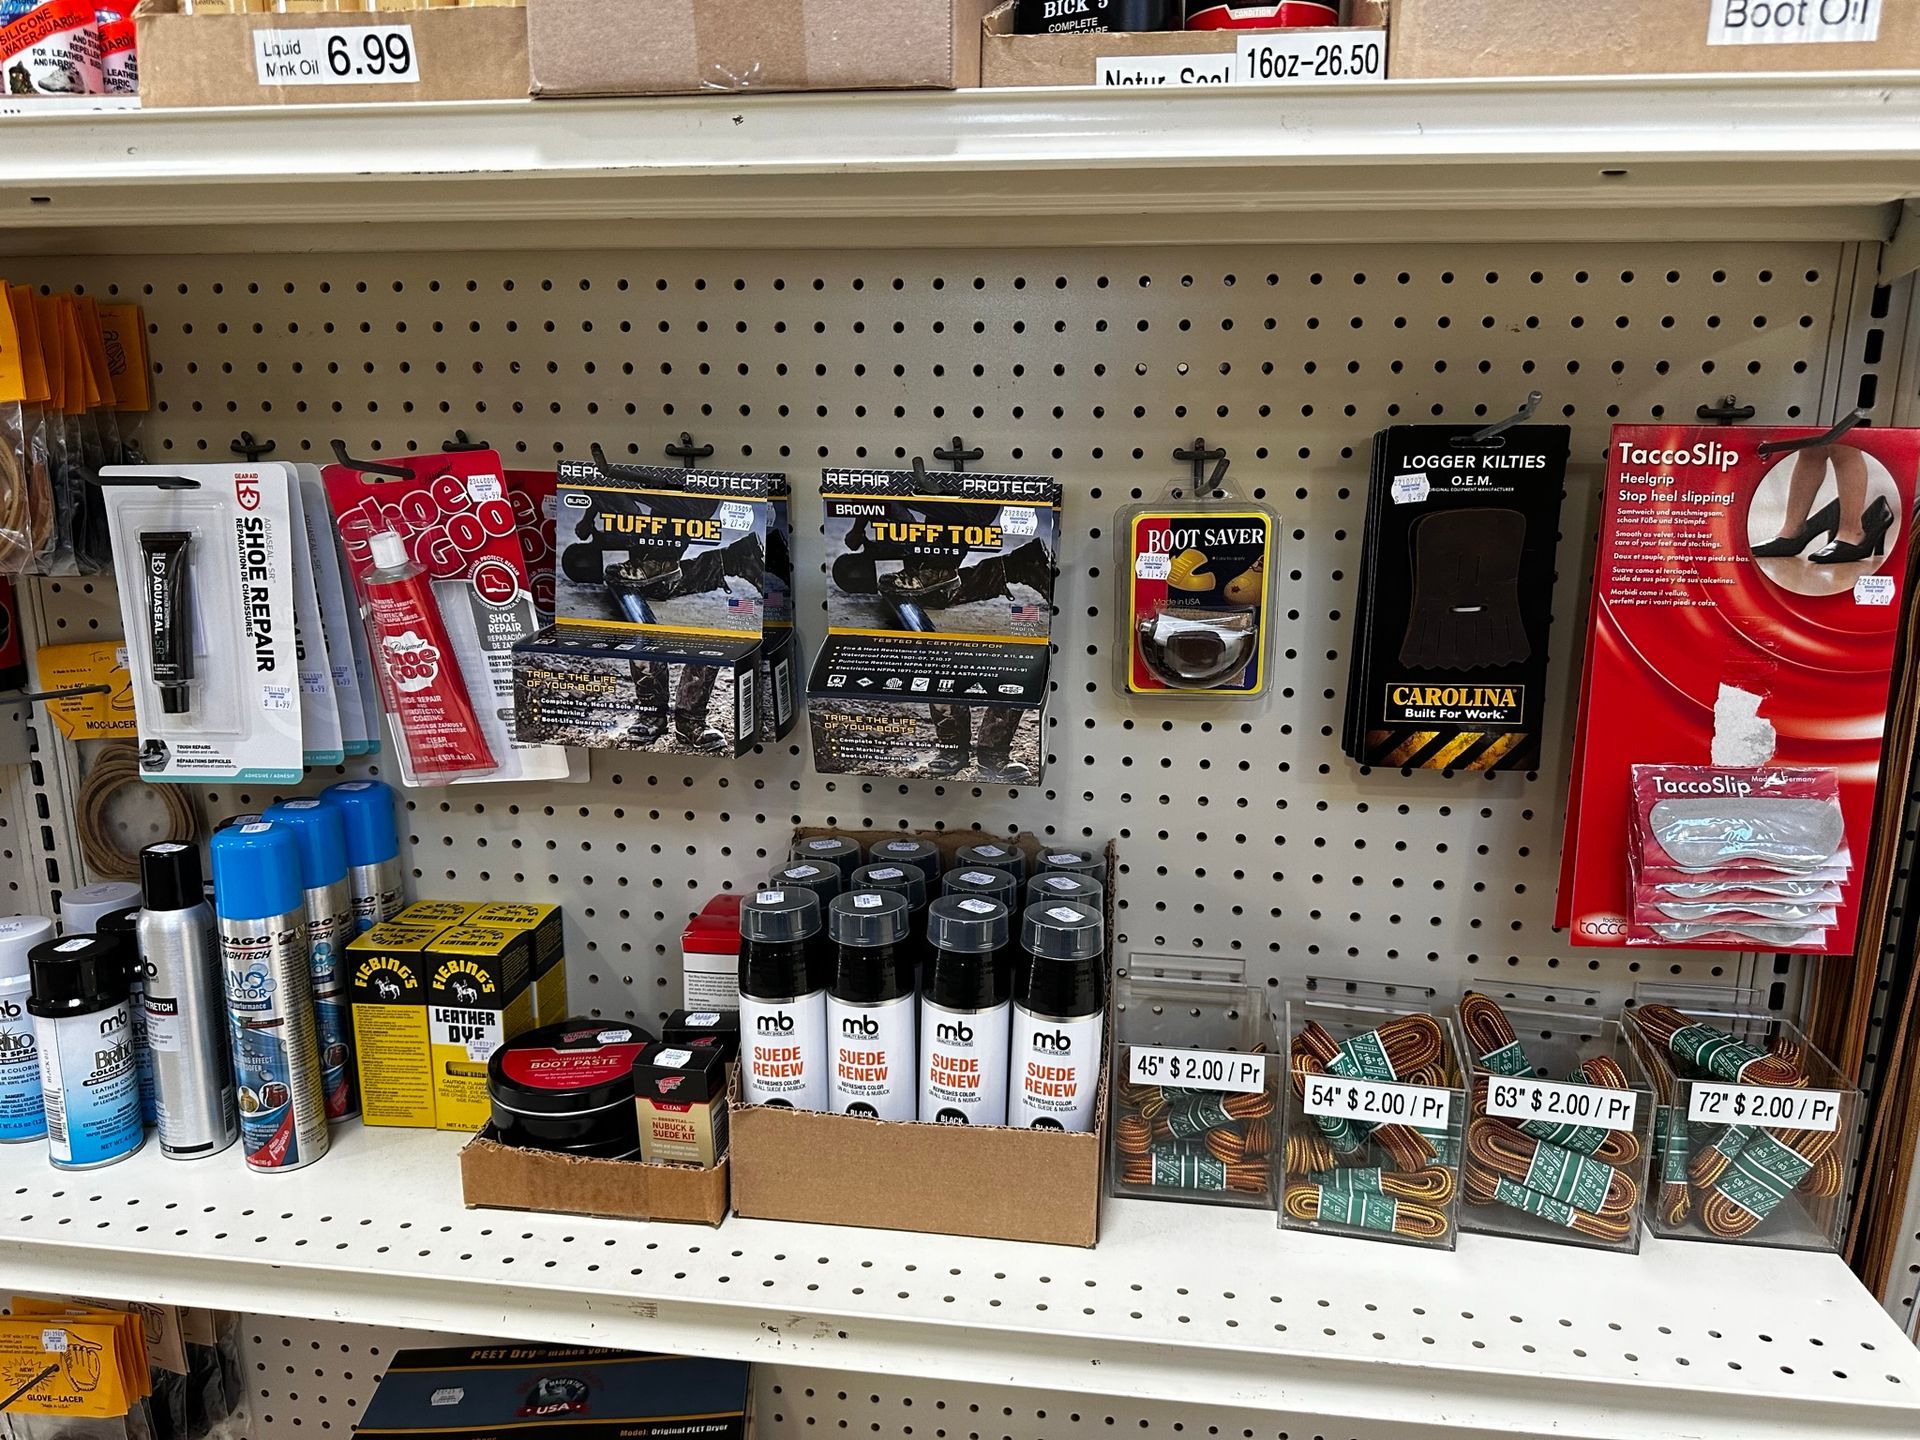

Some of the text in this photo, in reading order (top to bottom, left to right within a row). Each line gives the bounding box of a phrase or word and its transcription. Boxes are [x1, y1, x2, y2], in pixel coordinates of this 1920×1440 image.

[1725, 0, 1867, 27] Boot Oil
[0, 8, 53, 46] SILICONE
[1048, 17, 1098, 33] COMPLETE
[33, 48, 46, 56] FOR
[327, 33, 411, 76] 6.99
[300, 60, 319, 75] Oil
[1247, 43, 1379, 78] 16oz-26.50
[1403, 455, 1546, 468] LOGGER KILTIES
[1619, 442, 1738, 472] TaccoSlip
[686, 474, 763, 490] PROTECT
[826, 473, 1048, 494] REPAIR PROTECT
[1451, 476, 1493, 486] O.E.M.
[1620, 473, 1674, 486] Heelgrip
[1619, 490, 1734, 506] Stop heel slipping!
[836, 505, 885, 515] BROWN
[601, 513, 721, 539] TUFF TOE
[872, 522, 1003, 546] TUFF TOE
[415, 498, 516, 578] Goo
[639, 539, 682, 547] BOOTS
[1148, 528, 1264, 553] BOOT SAVER
[1688, 541, 1722, 549] stockings.
[914, 547, 959, 555] BOOTS
[235, 518, 253, 637] RÉPARATION DE CHAUSSURES
[245, 517, 275, 673] SHOE REPAIR
[1870, 595, 1889, 604] 2.00
[154, 576, 163, 635] AQUASEAL
[489, 613, 516, 623] SHOE
[488, 623, 522, 633] REPAIR
[527, 670, 616, 683] TRIPLE THE LIFE
[545, 682, 575, 690] YOUR
[578, 684, 615, 693] BOOTS
[1393, 687, 1516, 706] CAROLINA
[824, 714, 863, 723] TRIPLE
[892, 718, 917, 726] LIFE
[1405, 708, 1436, 718] Built
[1440, 709, 1461, 718] For
[843, 723, 874, 731] YOUR
[876, 726, 915, 734] BOOTS
[1652, 776, 1751, 798] TaccoSlip
[355, 956, 418, 989] FIEBING'S
[432, 960, 495, 993] FIEBING'S
[435, 1009, 496, 1026] LEATHER
[754, 1046, 801, 1062] SUEDE
[839, 1049, 886, 1066] SUEDE
[531, 1058, 617, 1069] BOOT PASTE
[753, 1061, 804, 1078] RENEW
[932, 1053, 979, 1072] SUEDE
[1138, 1055, 1260, 1083] 45" $ 2.00 / Pr
[90, 1064, 120, 1078] COLOR
[838, 1063, 888, 1081] RENEW
[930, 1068, 981, 1088] RENEW
[1027, 1062, 1075, 1081] SUEDE
[92, 1083, 118, 1095] LEATHER
[1024, 1077, 1077, 1098] RENEW
[1312, 1085, 1443, 1119] 54" $ 2.00 / Pr
[1495, 1086, 1630, 1120] 63" $ 2.00 / Pr
[1700, 1091, 1834, 1121] 72" $ 2.00 / Pr
[653, 1122, 686, 1131] NUBUCK
[940, 1115, 964, 1124] BLACK
[653, 1130, 680, 1139] SUEDE
[471, 1351, 504, 1360] PEET
[548, 1349, 585, 1357] makes
[536, 1403, 570, 1415] USA
[620, 1424, 728, 1437] Model: Original PEET Dryer
